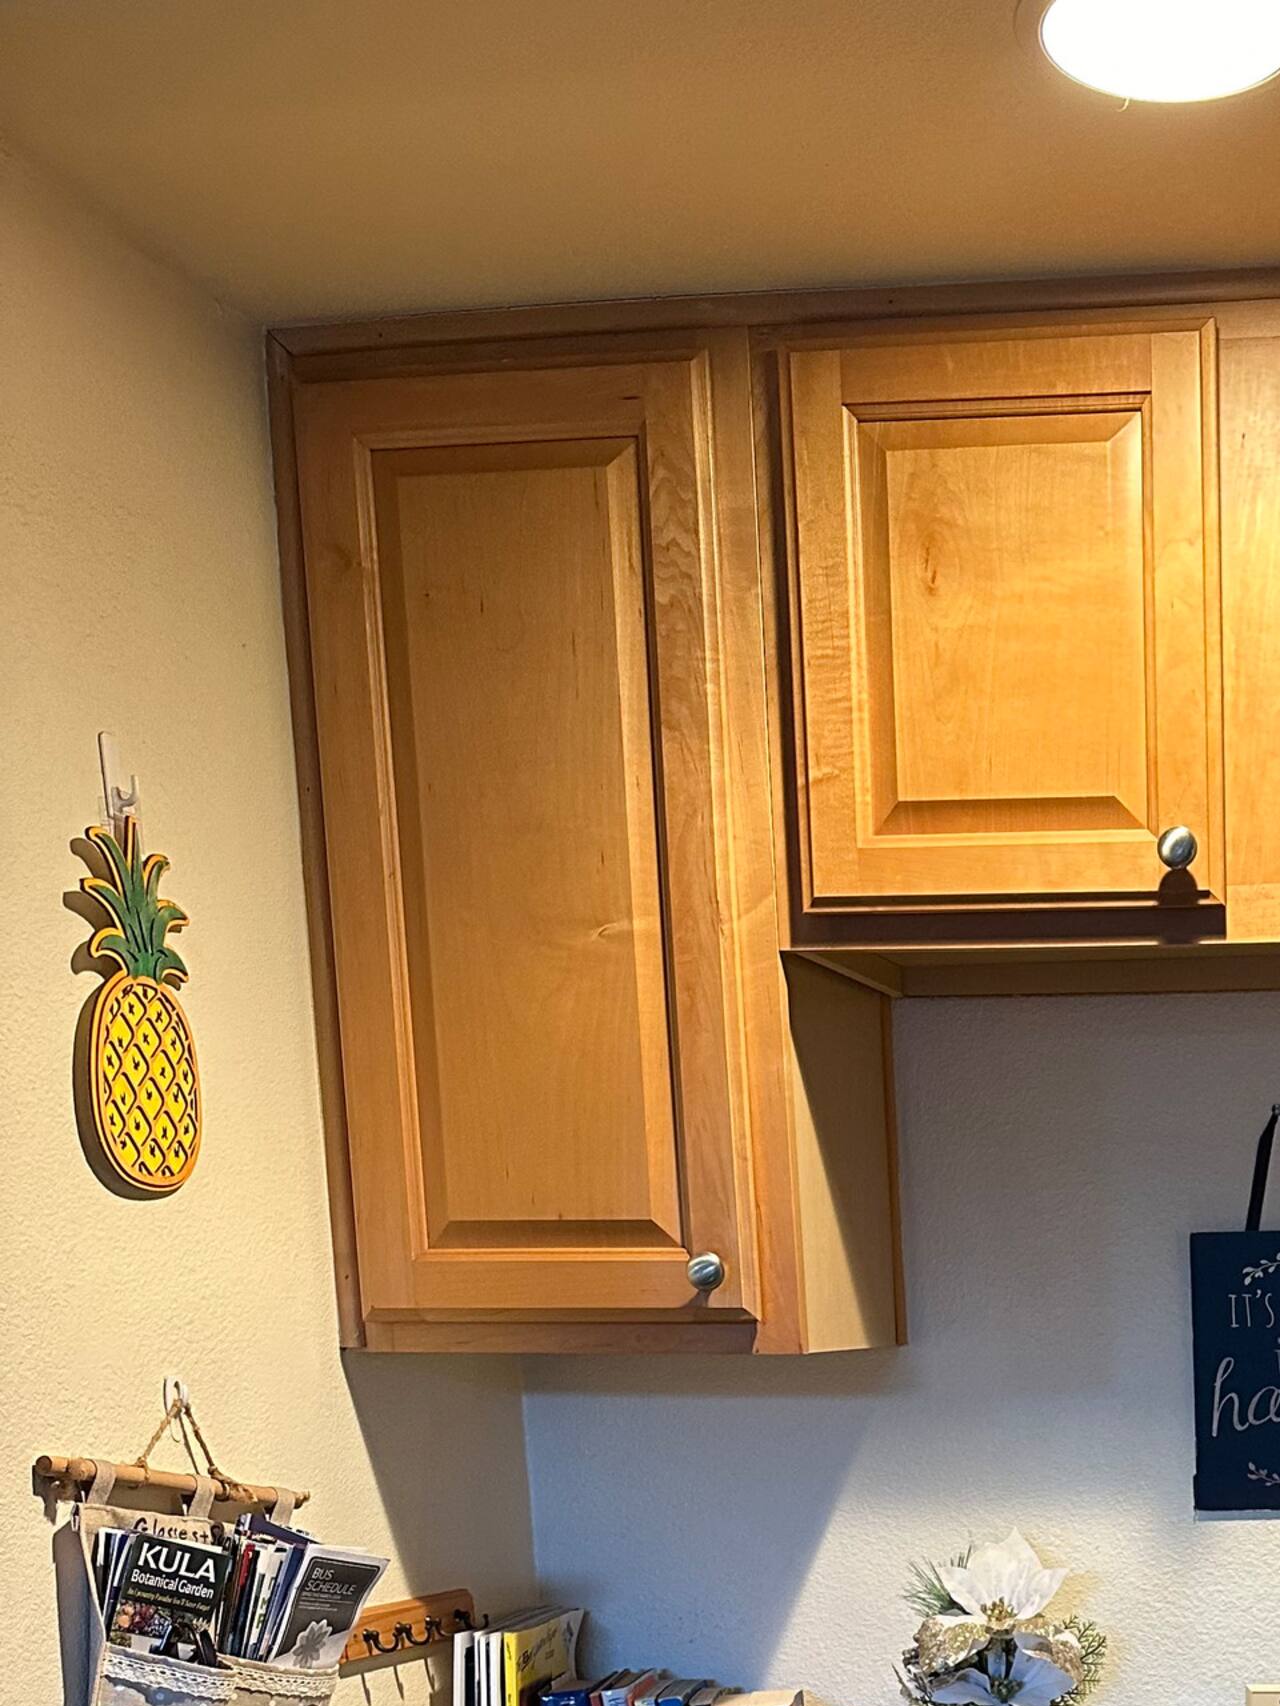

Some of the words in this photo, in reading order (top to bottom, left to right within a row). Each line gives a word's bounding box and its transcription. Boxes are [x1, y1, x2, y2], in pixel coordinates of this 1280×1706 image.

[1228, 1289, 1274, 1328] IT'S
[138, 1542, 215, 1583] KULA
[312, 1568, 335, 1580] BUS
[131, 1569, 179, 1591] Botanical
[178, 1580, 214, 1599] Garden
[305, 1580, 357, 1595] SCHEDULE
